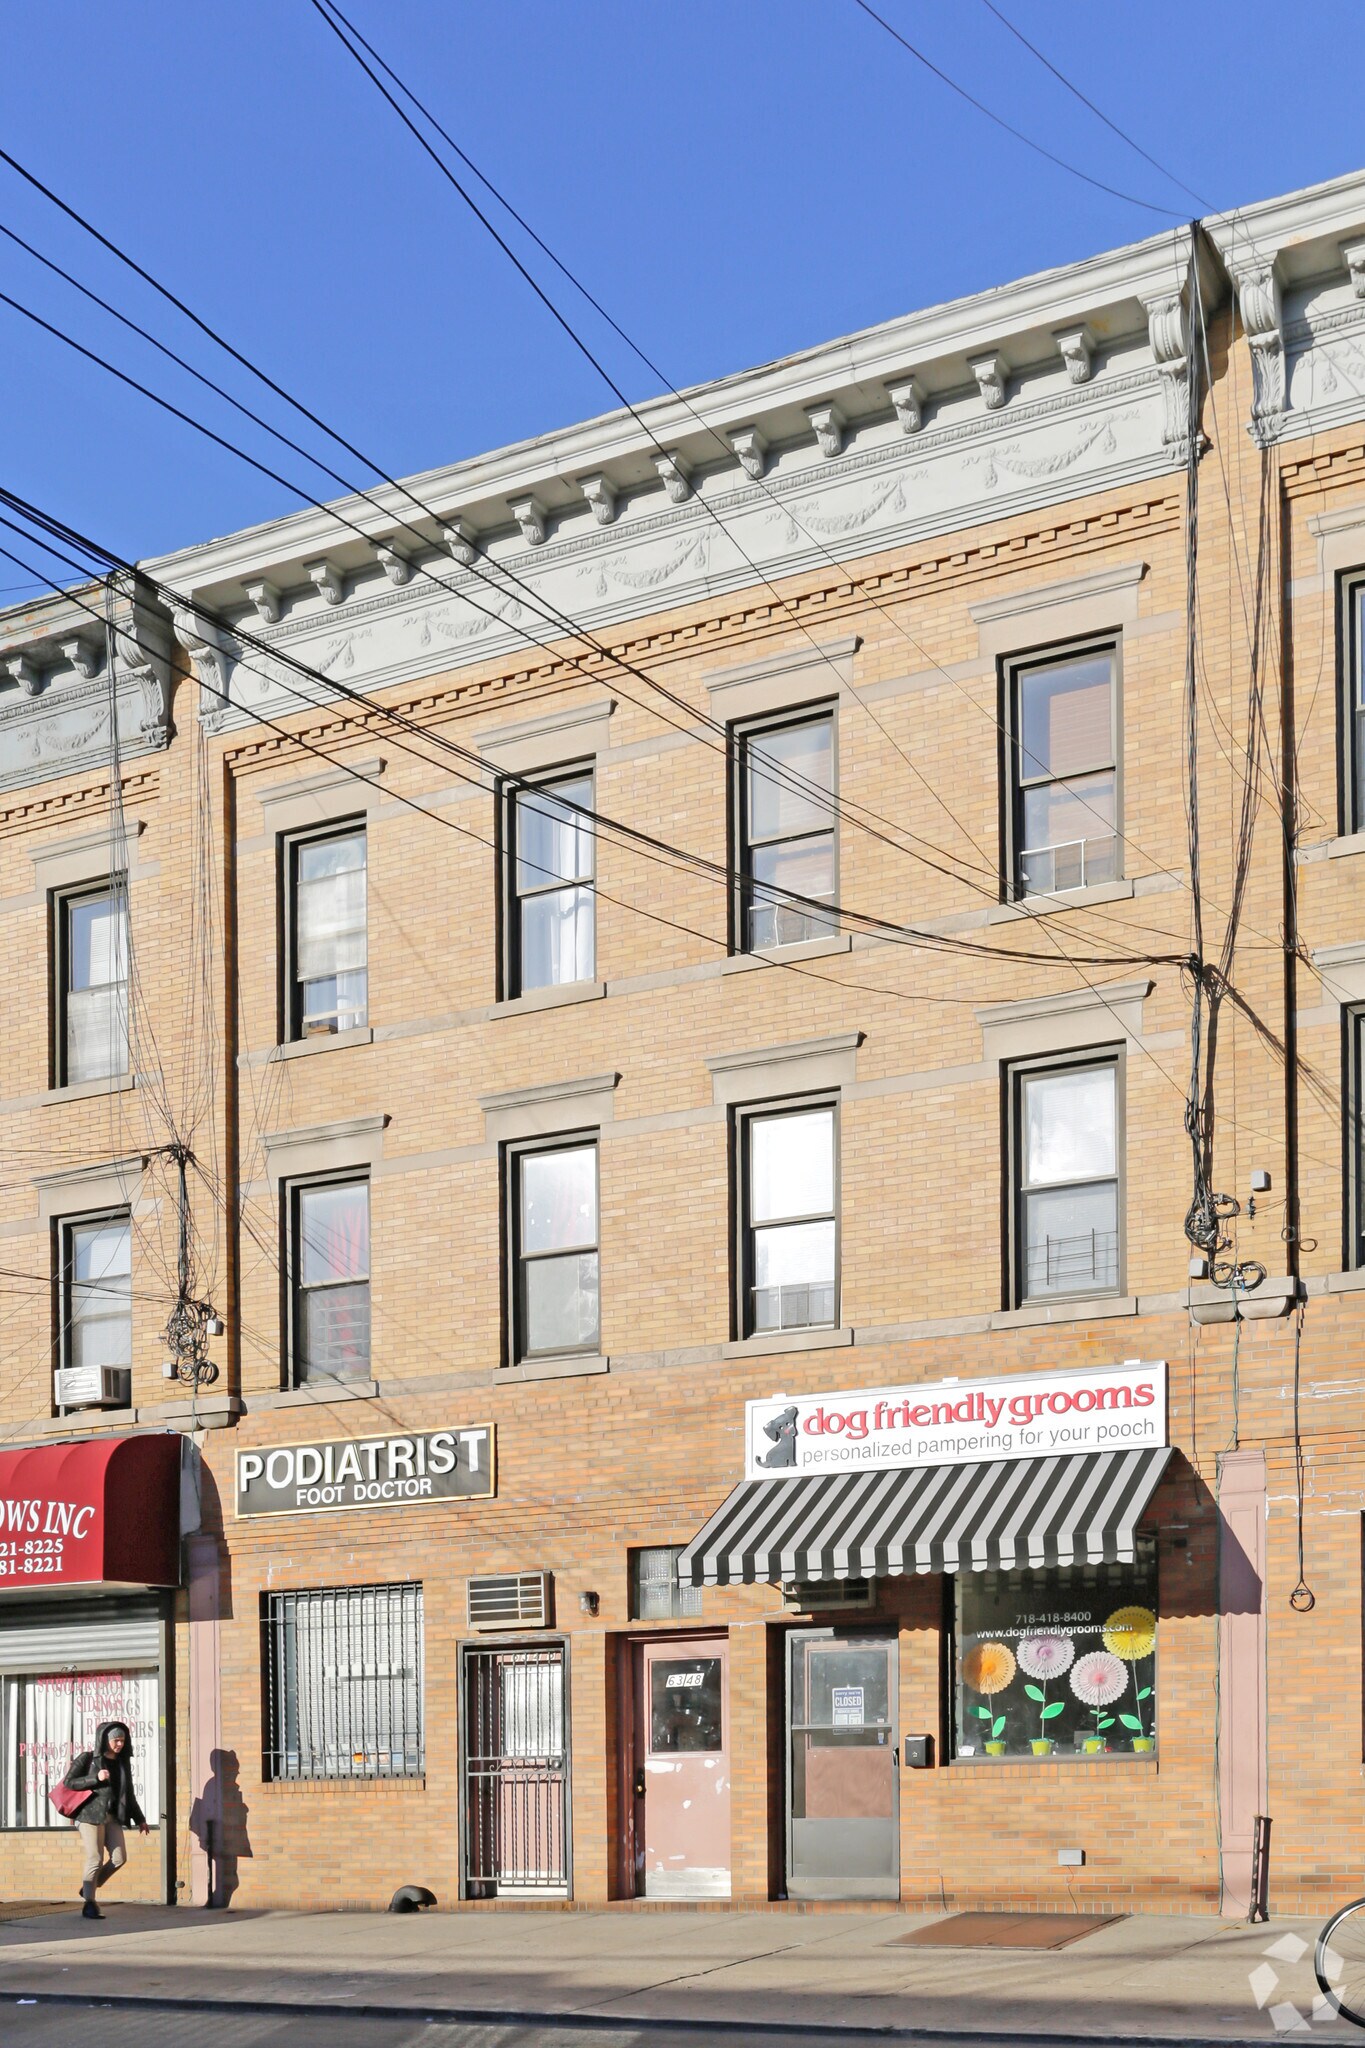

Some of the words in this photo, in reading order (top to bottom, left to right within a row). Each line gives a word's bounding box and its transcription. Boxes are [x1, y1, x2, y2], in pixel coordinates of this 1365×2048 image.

[803, 1439, 912, 1467] personalized
[917, 1431, 1012, 1458] pampering
[1019, 1428, 1043, 1445] for
[1050, 1426, 1090, 1446] your
[1097, 1418, 1154, 1442] pooch
[240, 1430, 486, 1492] PODIATRIST
[296, 1485, 346, 1505] FOOT
[353, 1478, 432, 1501] DOCTOR
[42, 1501, 96, 1539] INC
[0, 1538, 64, 1557] 21-8225
[0, 1556, 63, 1575] 81-8221
[1015, 1611, 1092, 1624] 718-418-8400
[976, 1623, 1133, 1639] www.dogfriendlygrooms.com
[668, 1674, 702, 1686] 6348
[835, 1696, 862, 1707] CLOSED
